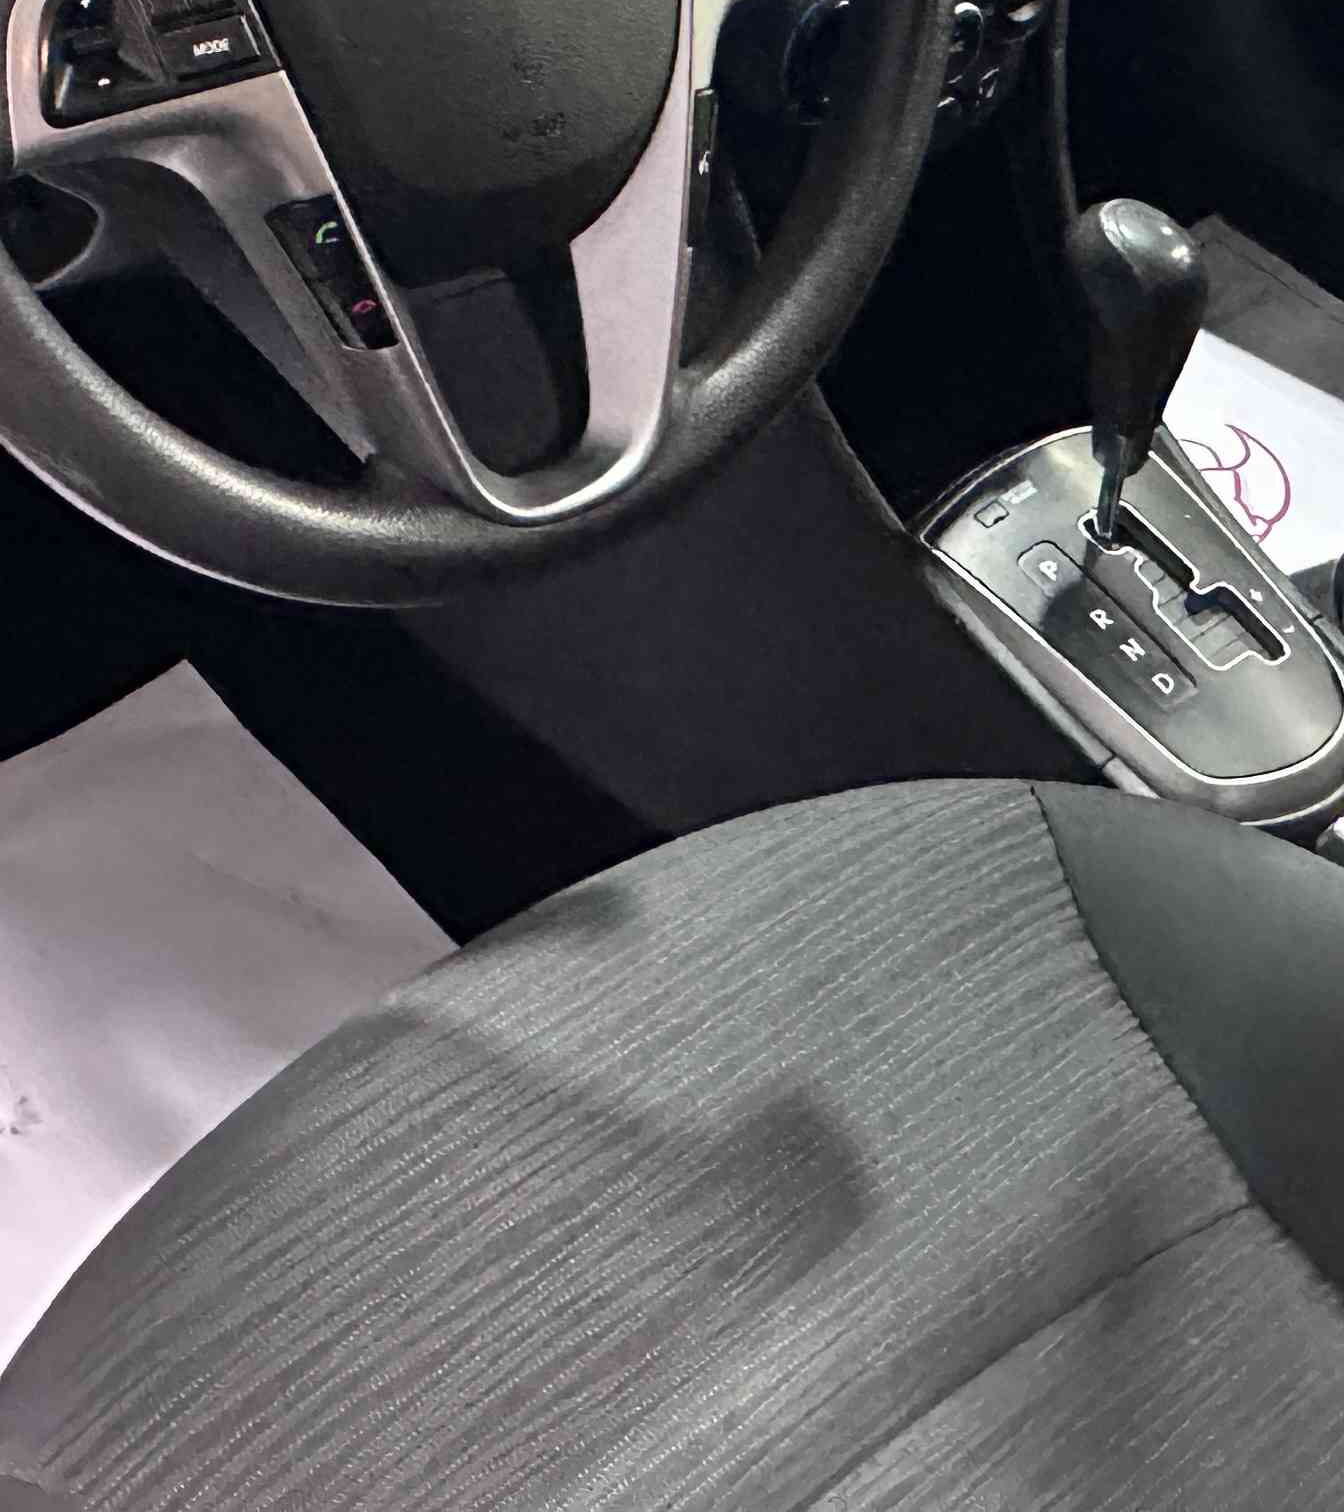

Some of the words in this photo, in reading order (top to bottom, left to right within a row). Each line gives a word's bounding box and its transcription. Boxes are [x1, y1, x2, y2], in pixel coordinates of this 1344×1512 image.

[1038, 559, 1058, 583] P
[1089, 608, 1115, 631] R
[1119, 638, 1147, 663] N
[1151, 672, 1175, 695] D
